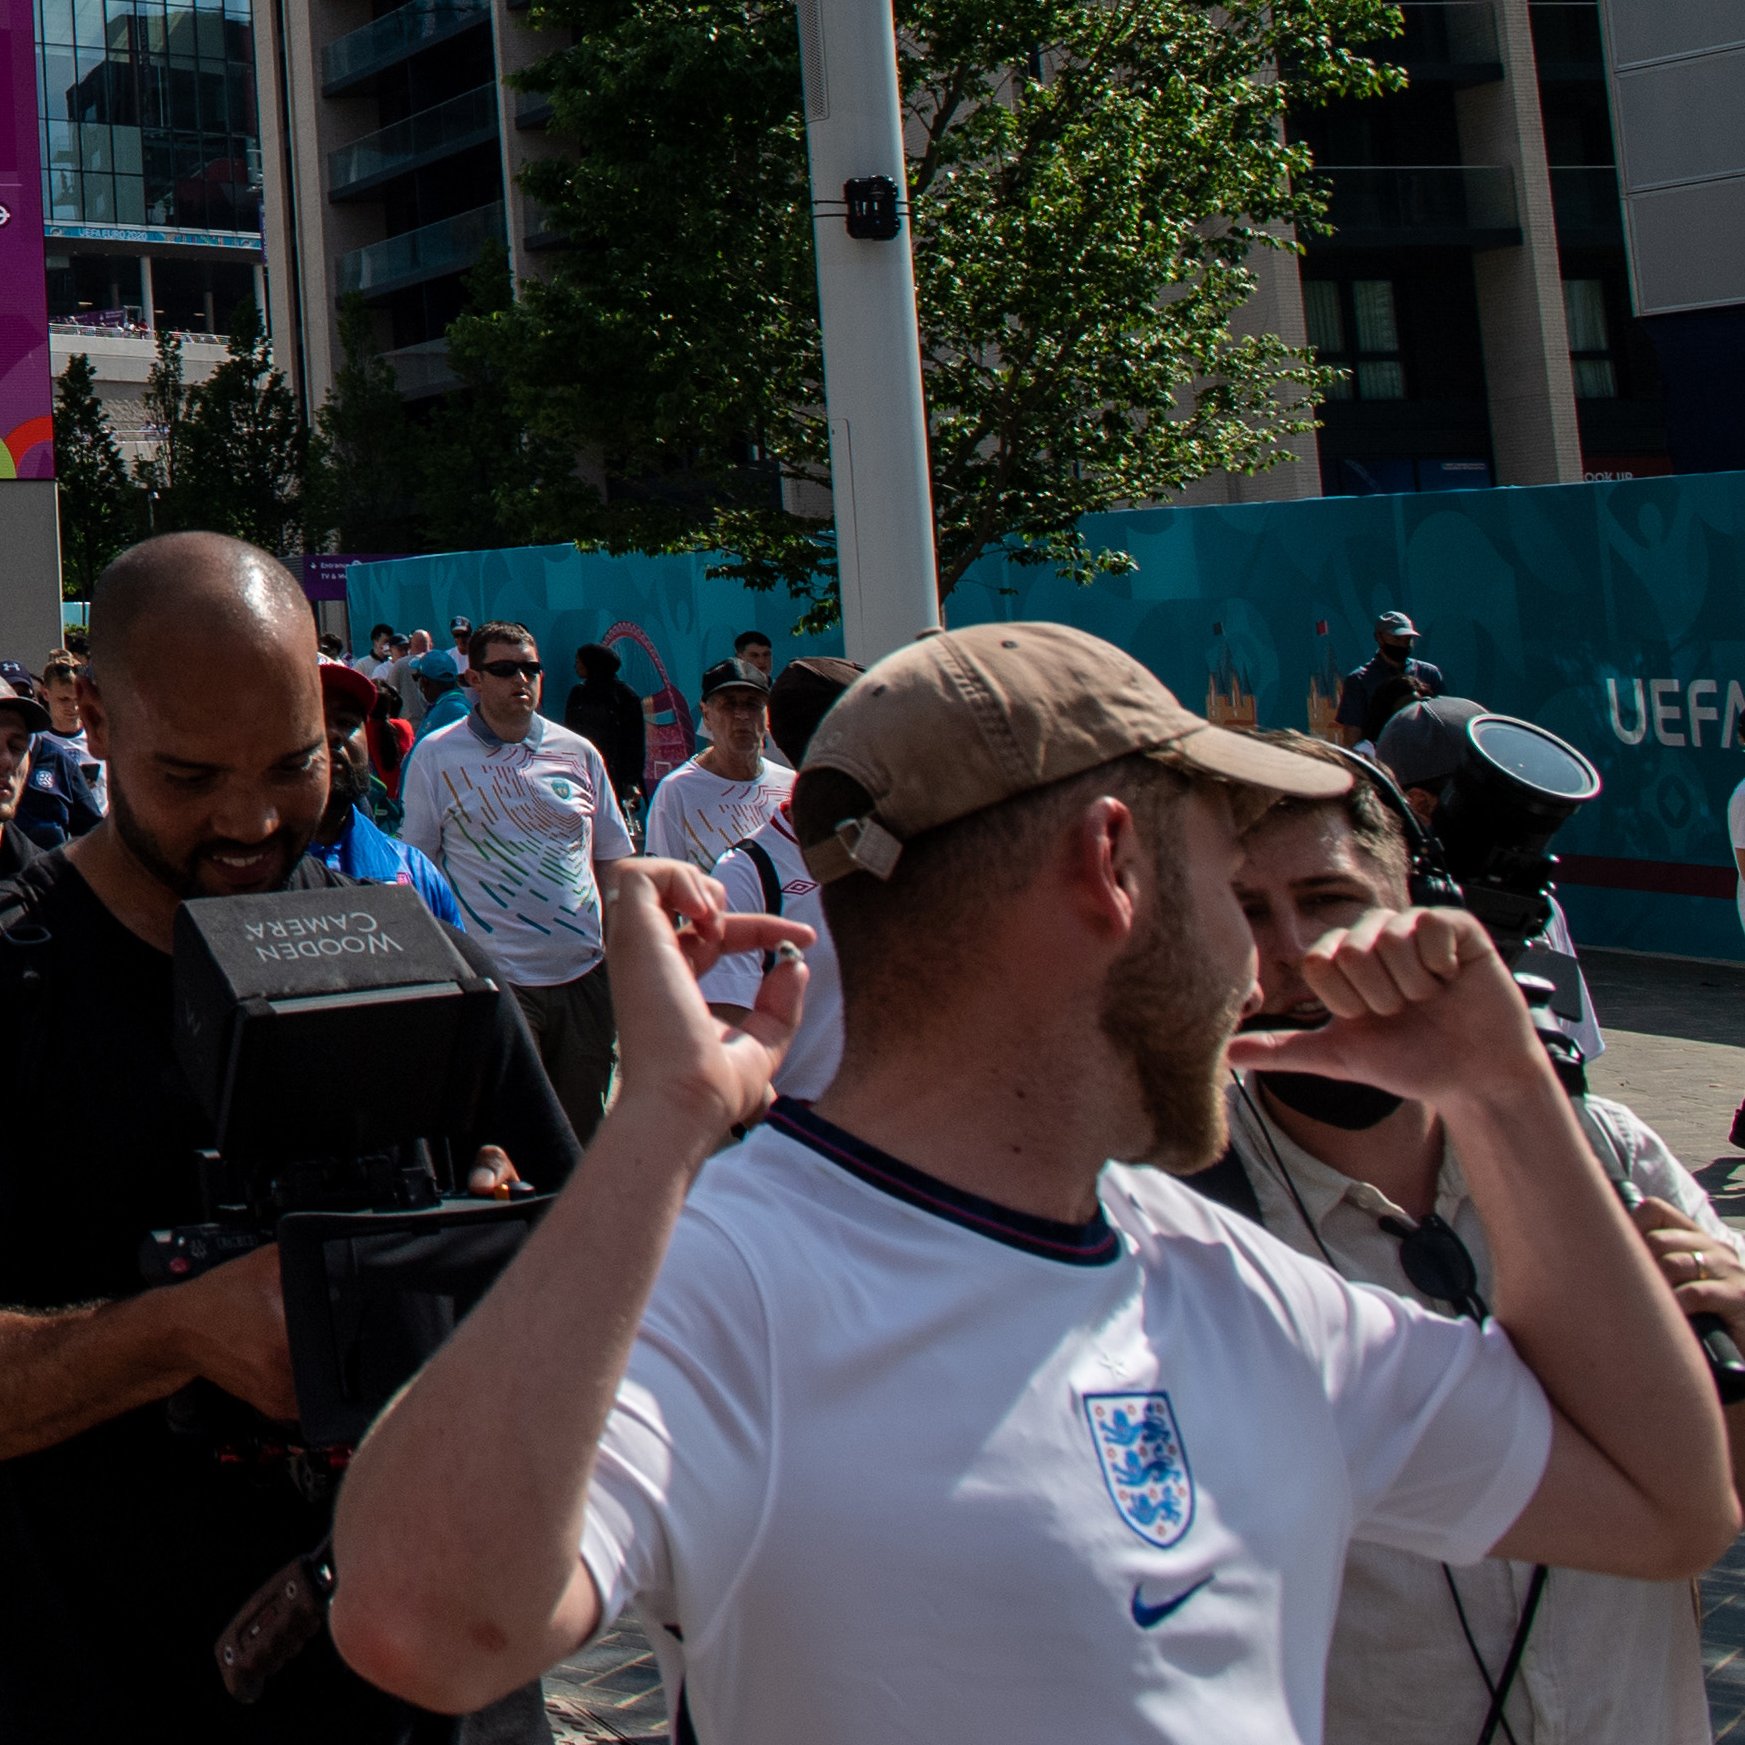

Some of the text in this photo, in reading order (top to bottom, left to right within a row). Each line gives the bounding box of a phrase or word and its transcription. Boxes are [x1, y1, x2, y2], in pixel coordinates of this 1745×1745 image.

[1583, 471, 1613, 482] OOK
[246, 912, 378, 939] CAMERA
[255, 932, 404, 962] WOODEN
